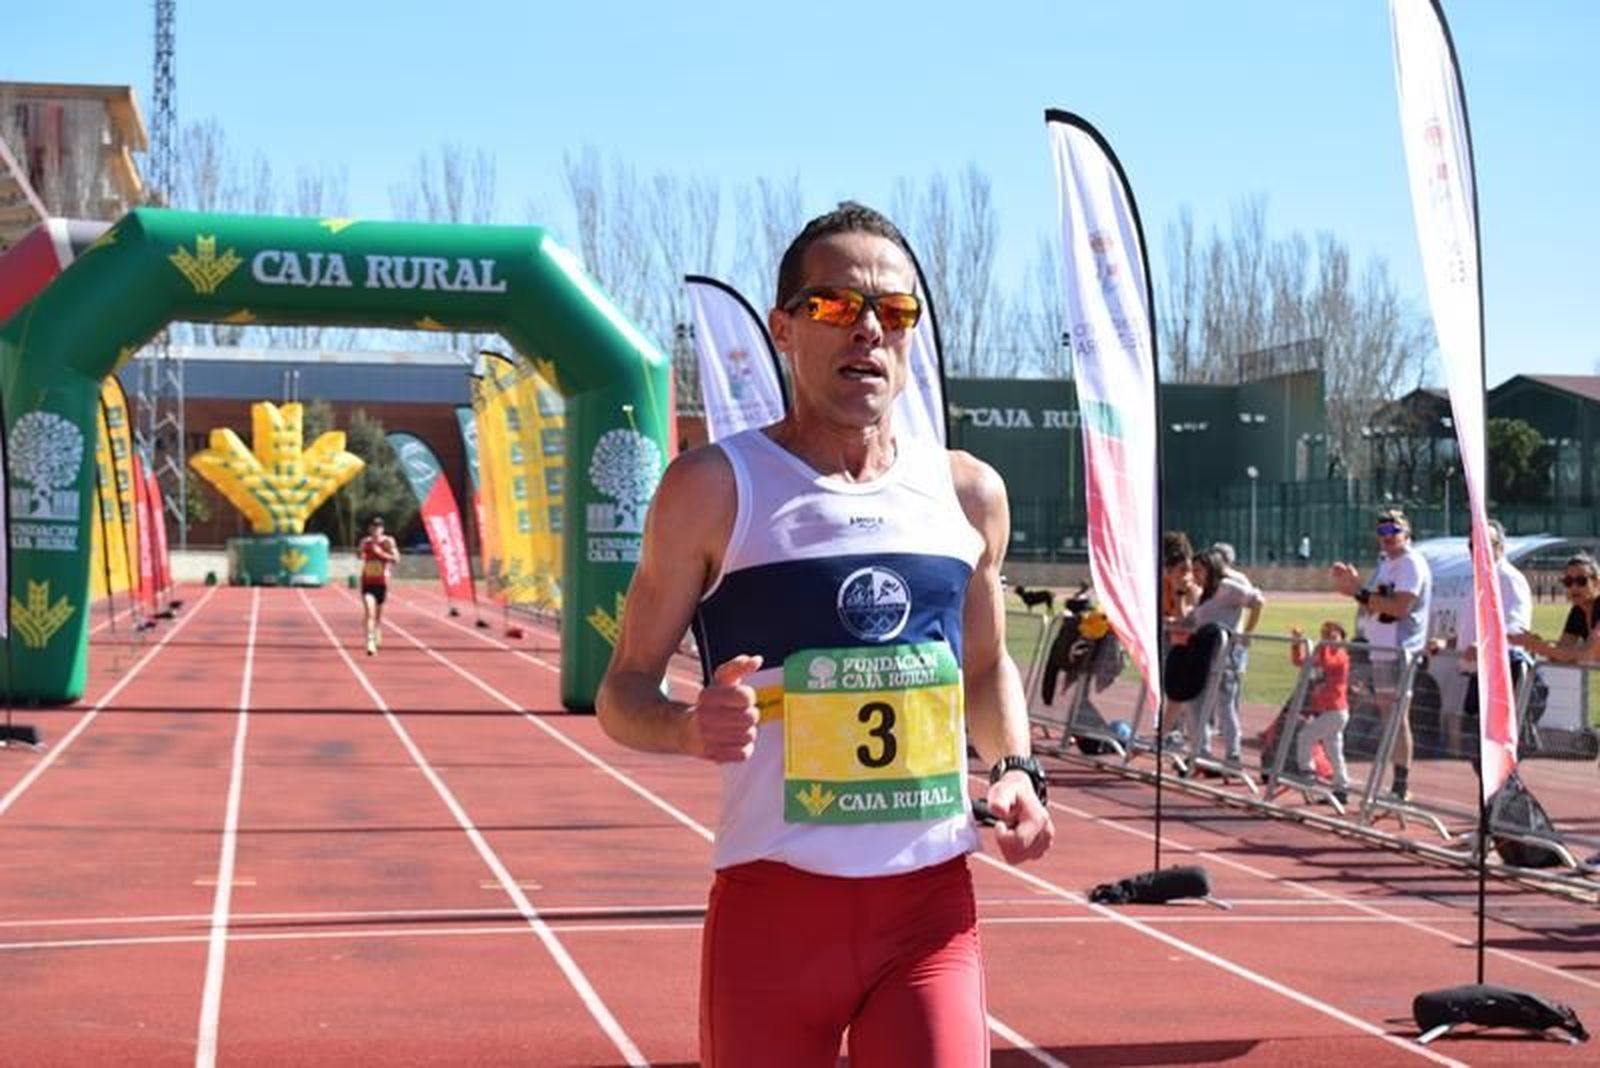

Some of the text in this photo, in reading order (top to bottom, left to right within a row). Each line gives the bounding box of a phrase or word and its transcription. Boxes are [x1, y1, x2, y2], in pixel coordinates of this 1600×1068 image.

[252, 250, 507, 292] CAJA RURAL
[969, 407, 1080, 428] CAJA RU
[841, 651, 939, 673] FUNDACION
[841, 669, 940, 688] CAJA RURAL
[856, 701, 897, 768] 3
[838, 786, 954, 812] CAJA RURAL
